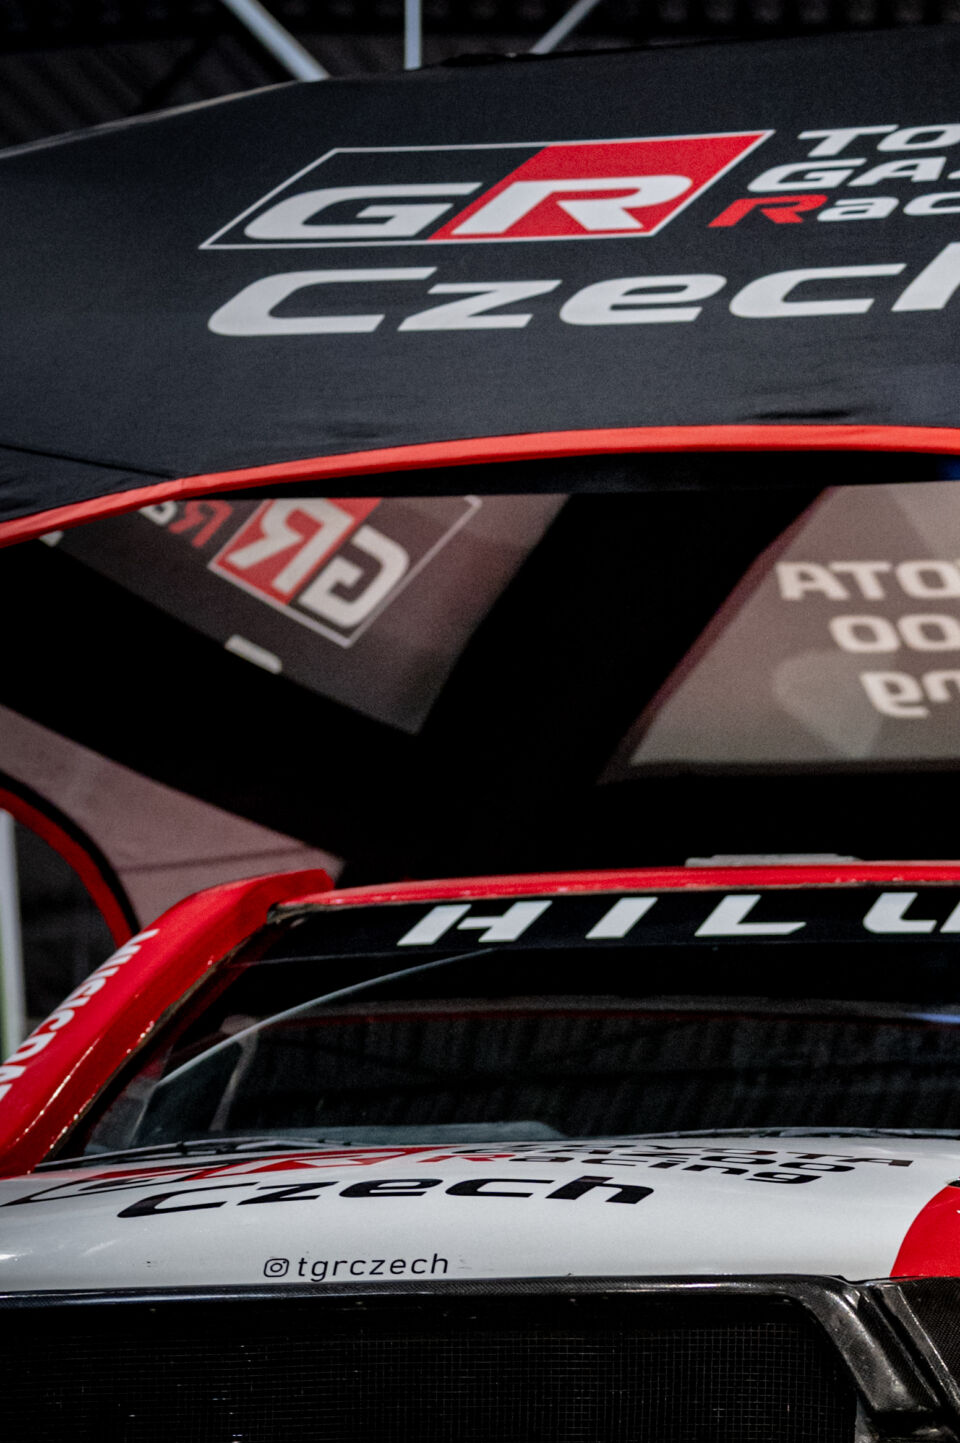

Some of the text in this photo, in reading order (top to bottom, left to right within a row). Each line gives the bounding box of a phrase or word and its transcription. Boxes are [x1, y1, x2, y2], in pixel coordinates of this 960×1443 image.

[244, 174, 693, 240] GR
[416, 1154, 822, 1184] Racing
[117, 1176, 655, 1218] Czech
